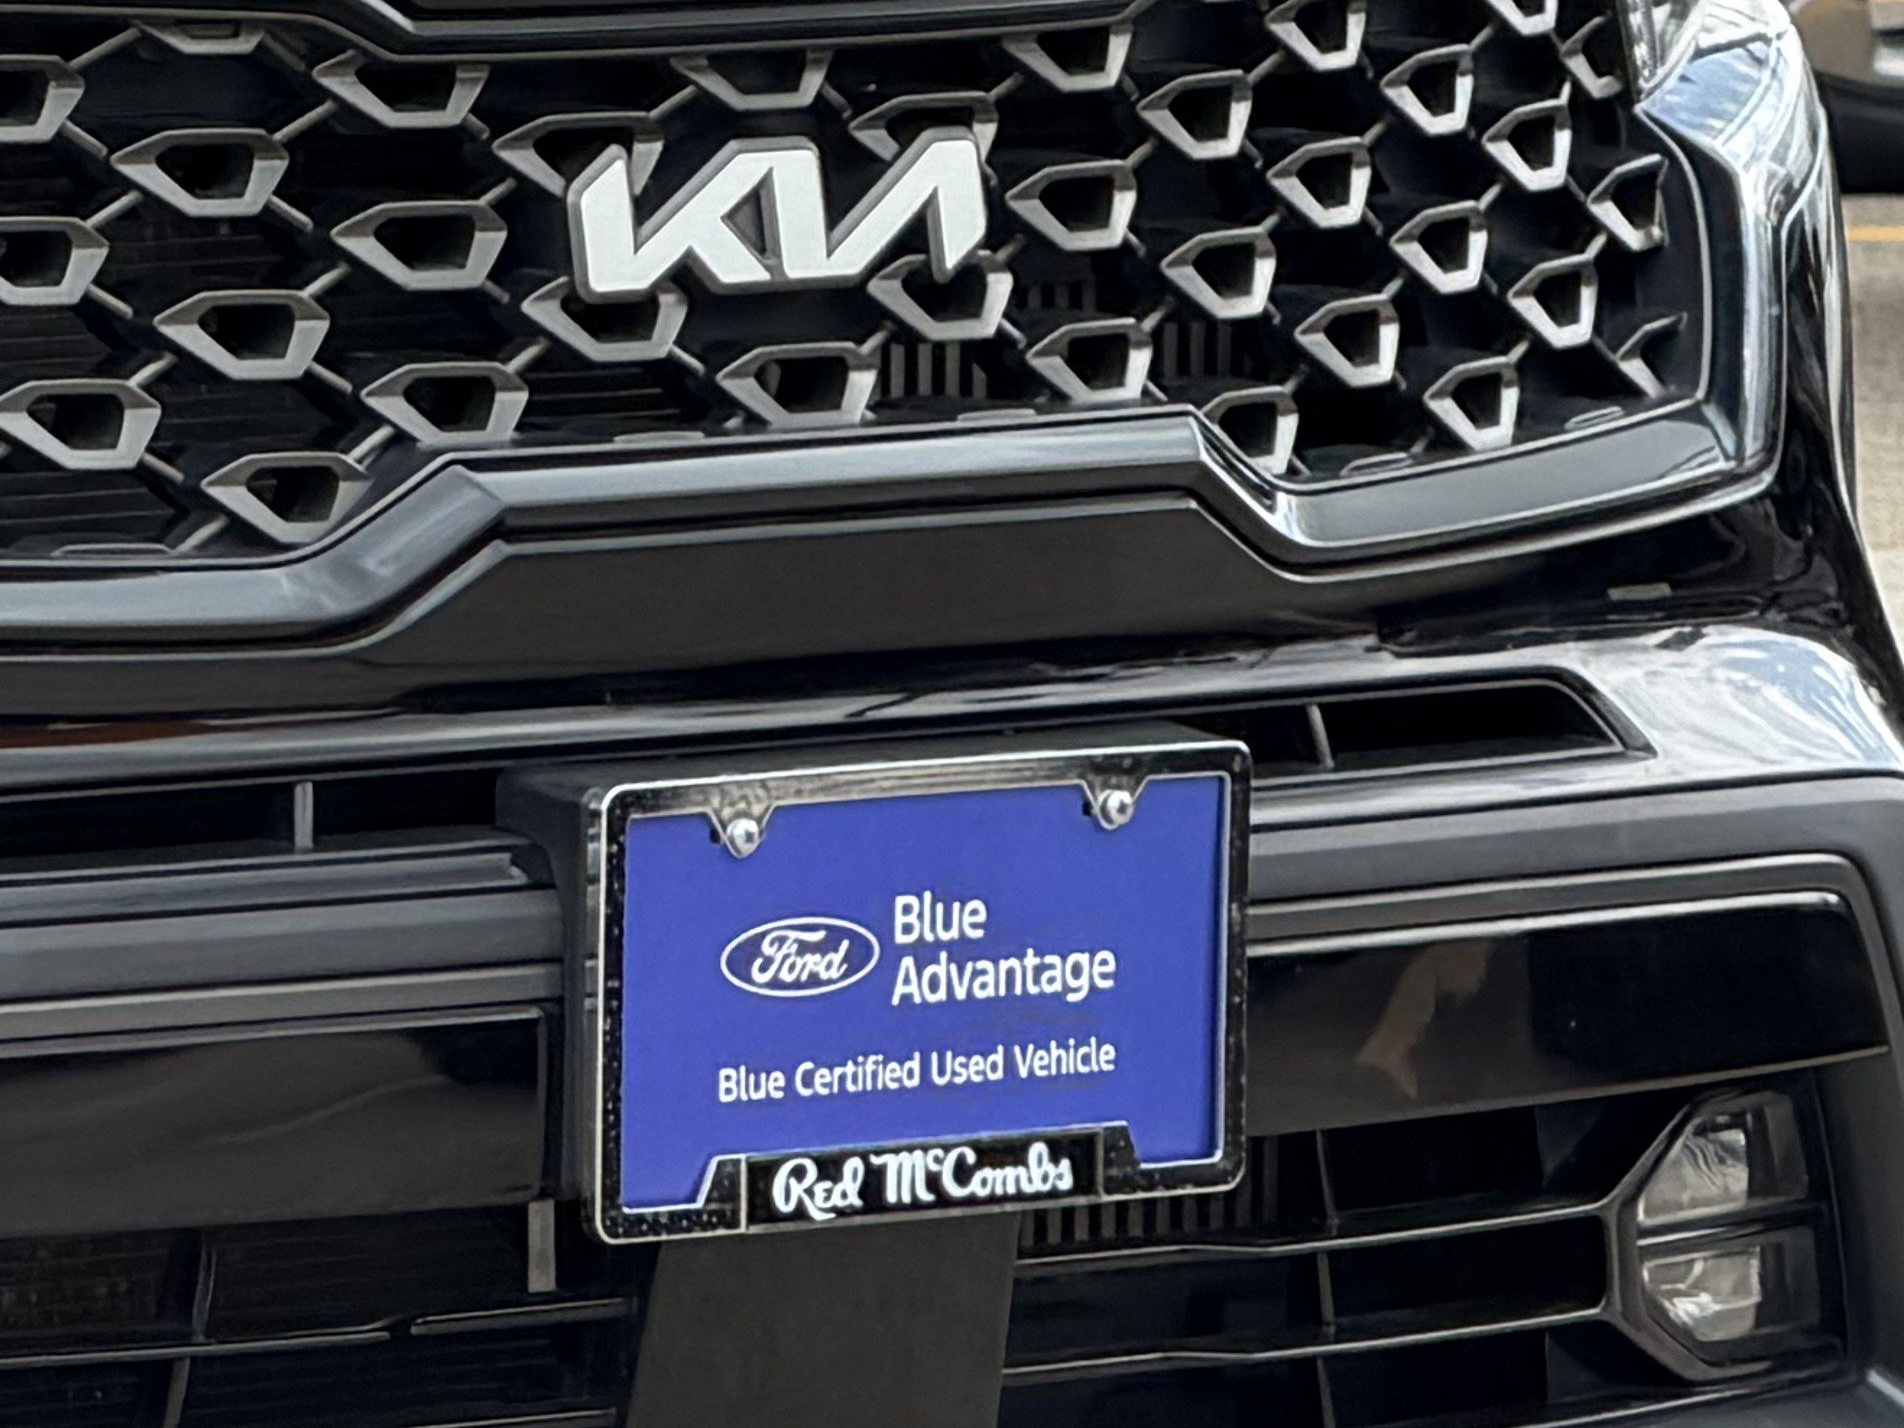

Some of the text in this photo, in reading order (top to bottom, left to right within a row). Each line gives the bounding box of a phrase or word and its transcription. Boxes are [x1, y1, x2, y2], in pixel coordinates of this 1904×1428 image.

[568, 134, 988, 305] KIA
[894, 891, 986, 944] Blue
[751, 929, 849, 983] Ford
[892, 948, 1116, 1006] Advantage
[719, 1036, 1115, 1103] Blue Certified Used Vehicle
[772, 1141, 1073, 1221] Red McCombs
